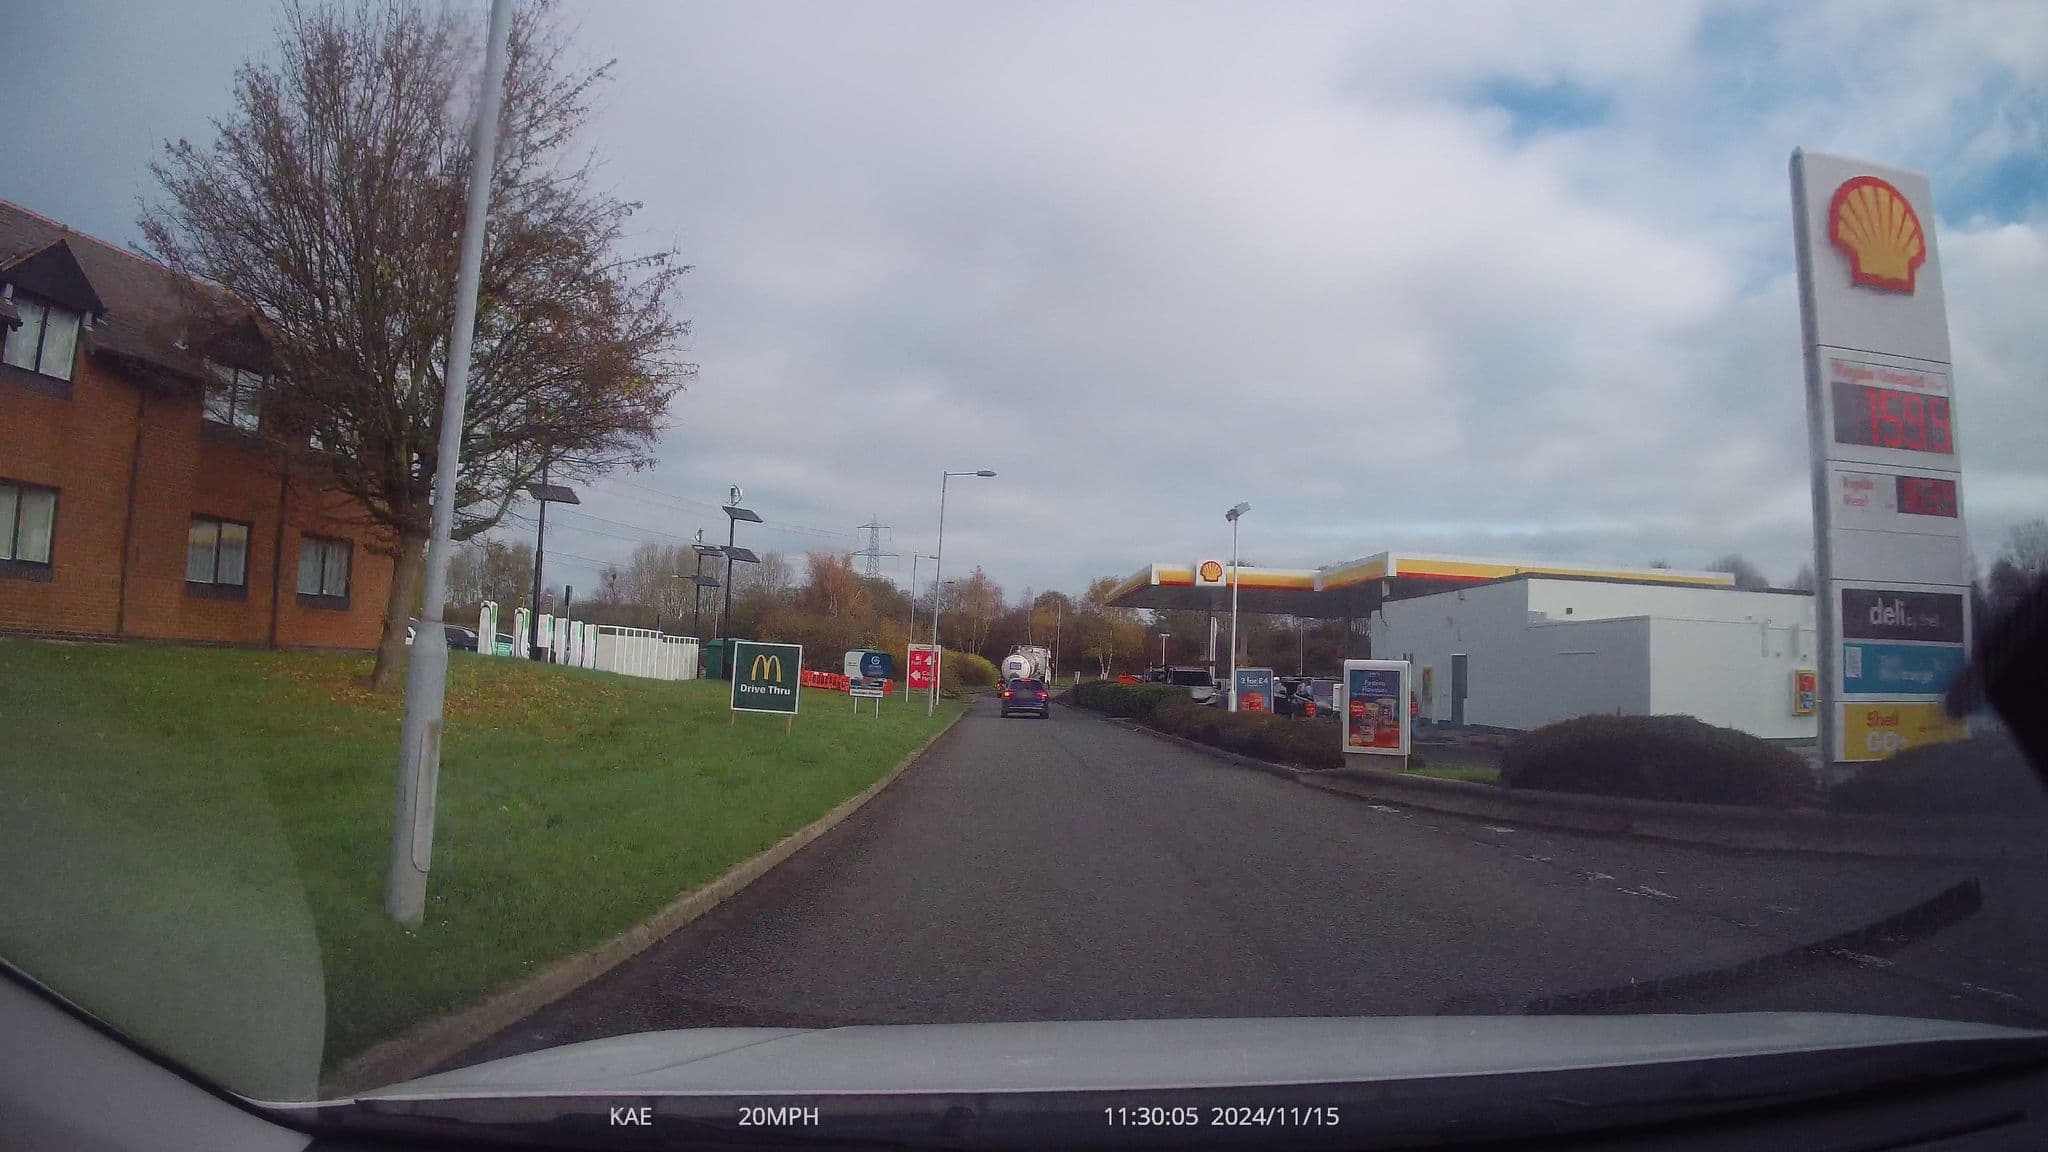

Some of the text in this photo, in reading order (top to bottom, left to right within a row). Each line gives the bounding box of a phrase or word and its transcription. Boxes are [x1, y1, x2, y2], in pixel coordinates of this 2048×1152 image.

[1869, 597, 1905, 626] deli
[740, 683, 791, 695] Drive Thru
